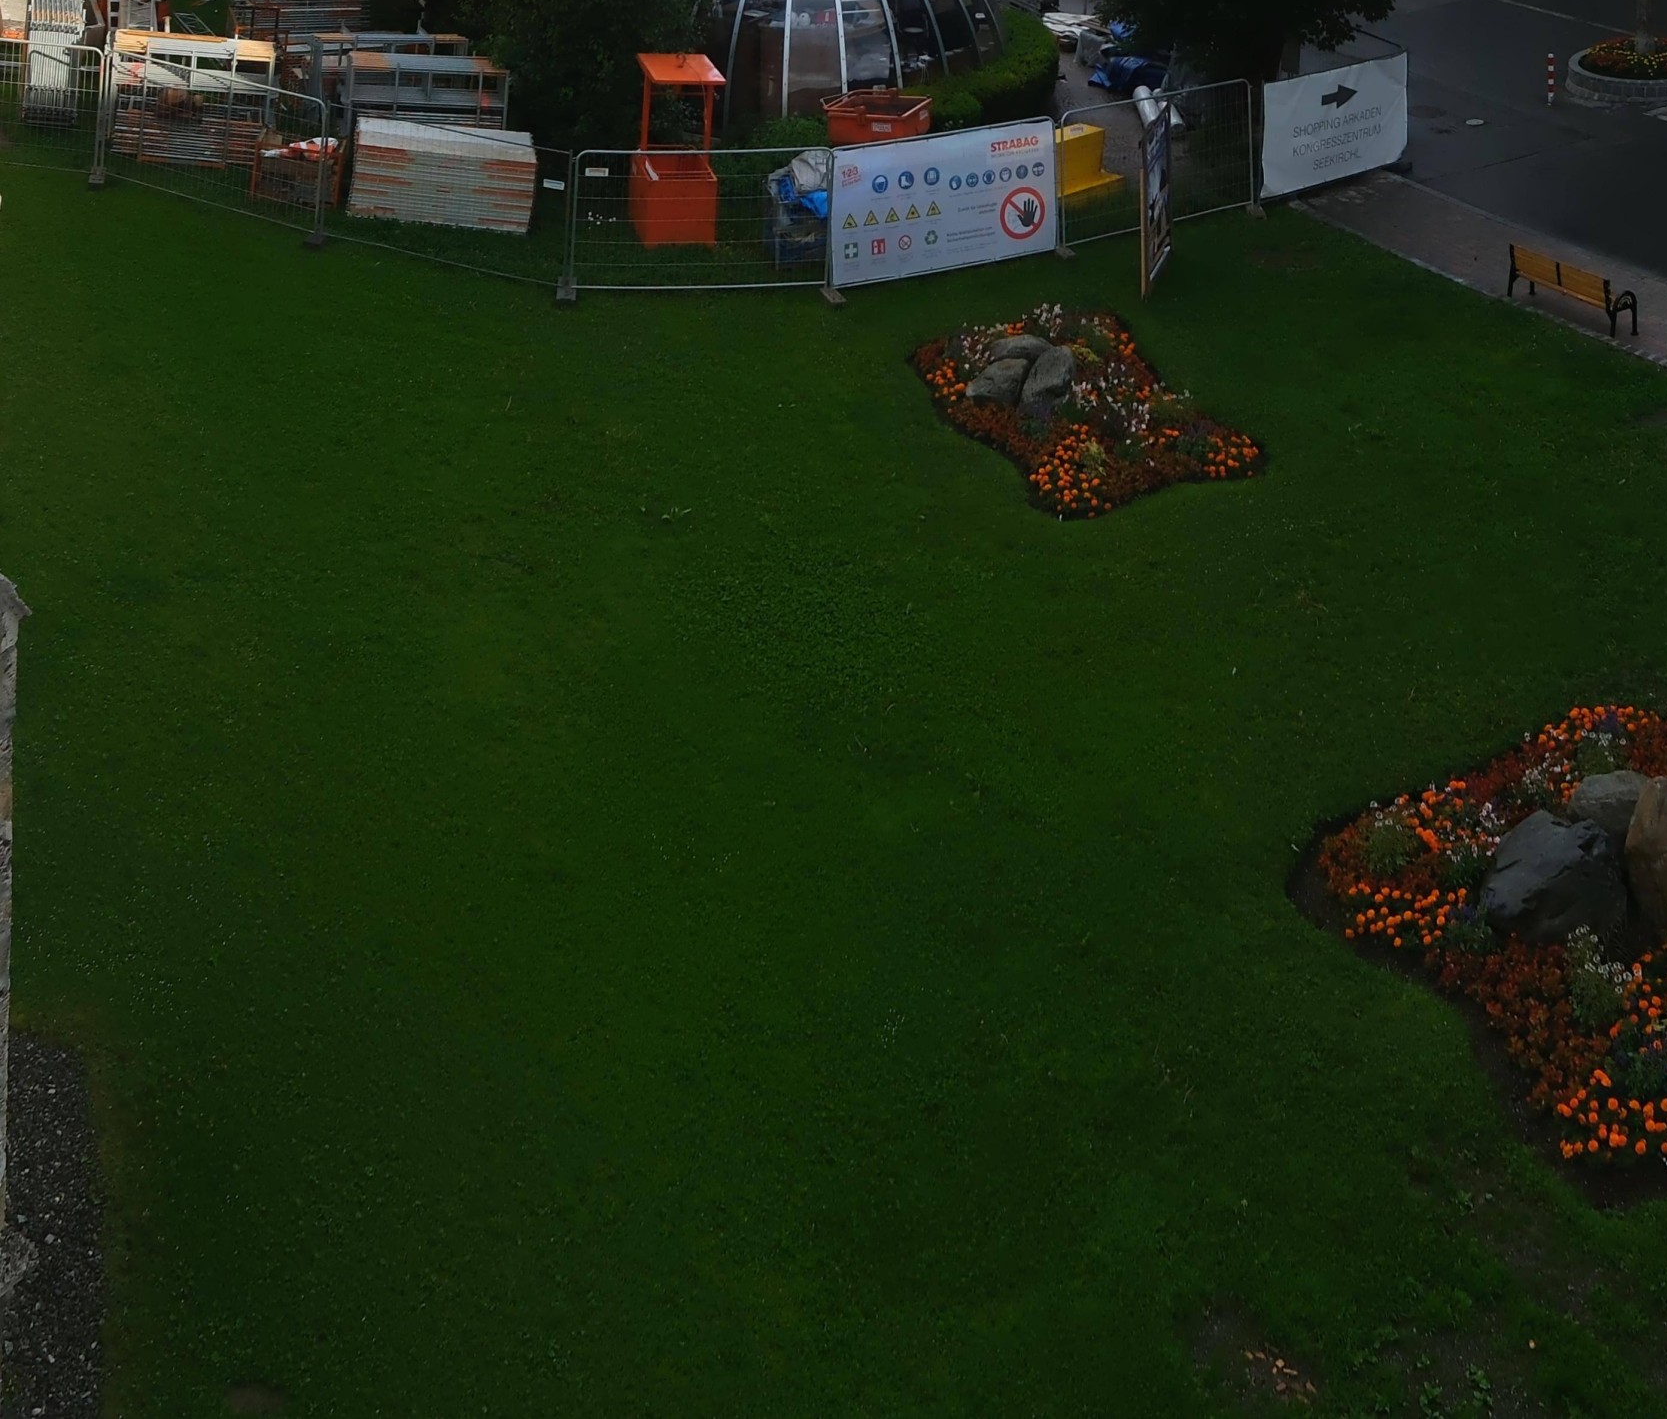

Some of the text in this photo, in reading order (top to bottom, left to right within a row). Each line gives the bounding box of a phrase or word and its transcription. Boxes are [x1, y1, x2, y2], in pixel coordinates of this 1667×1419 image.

[1293, 105, 1382, 139] SHOPPING ARKADEN
[990, 136, 1039, 153] STRABAG
[1292, 123, 1382, 157] KONGRESSZENTRUM
